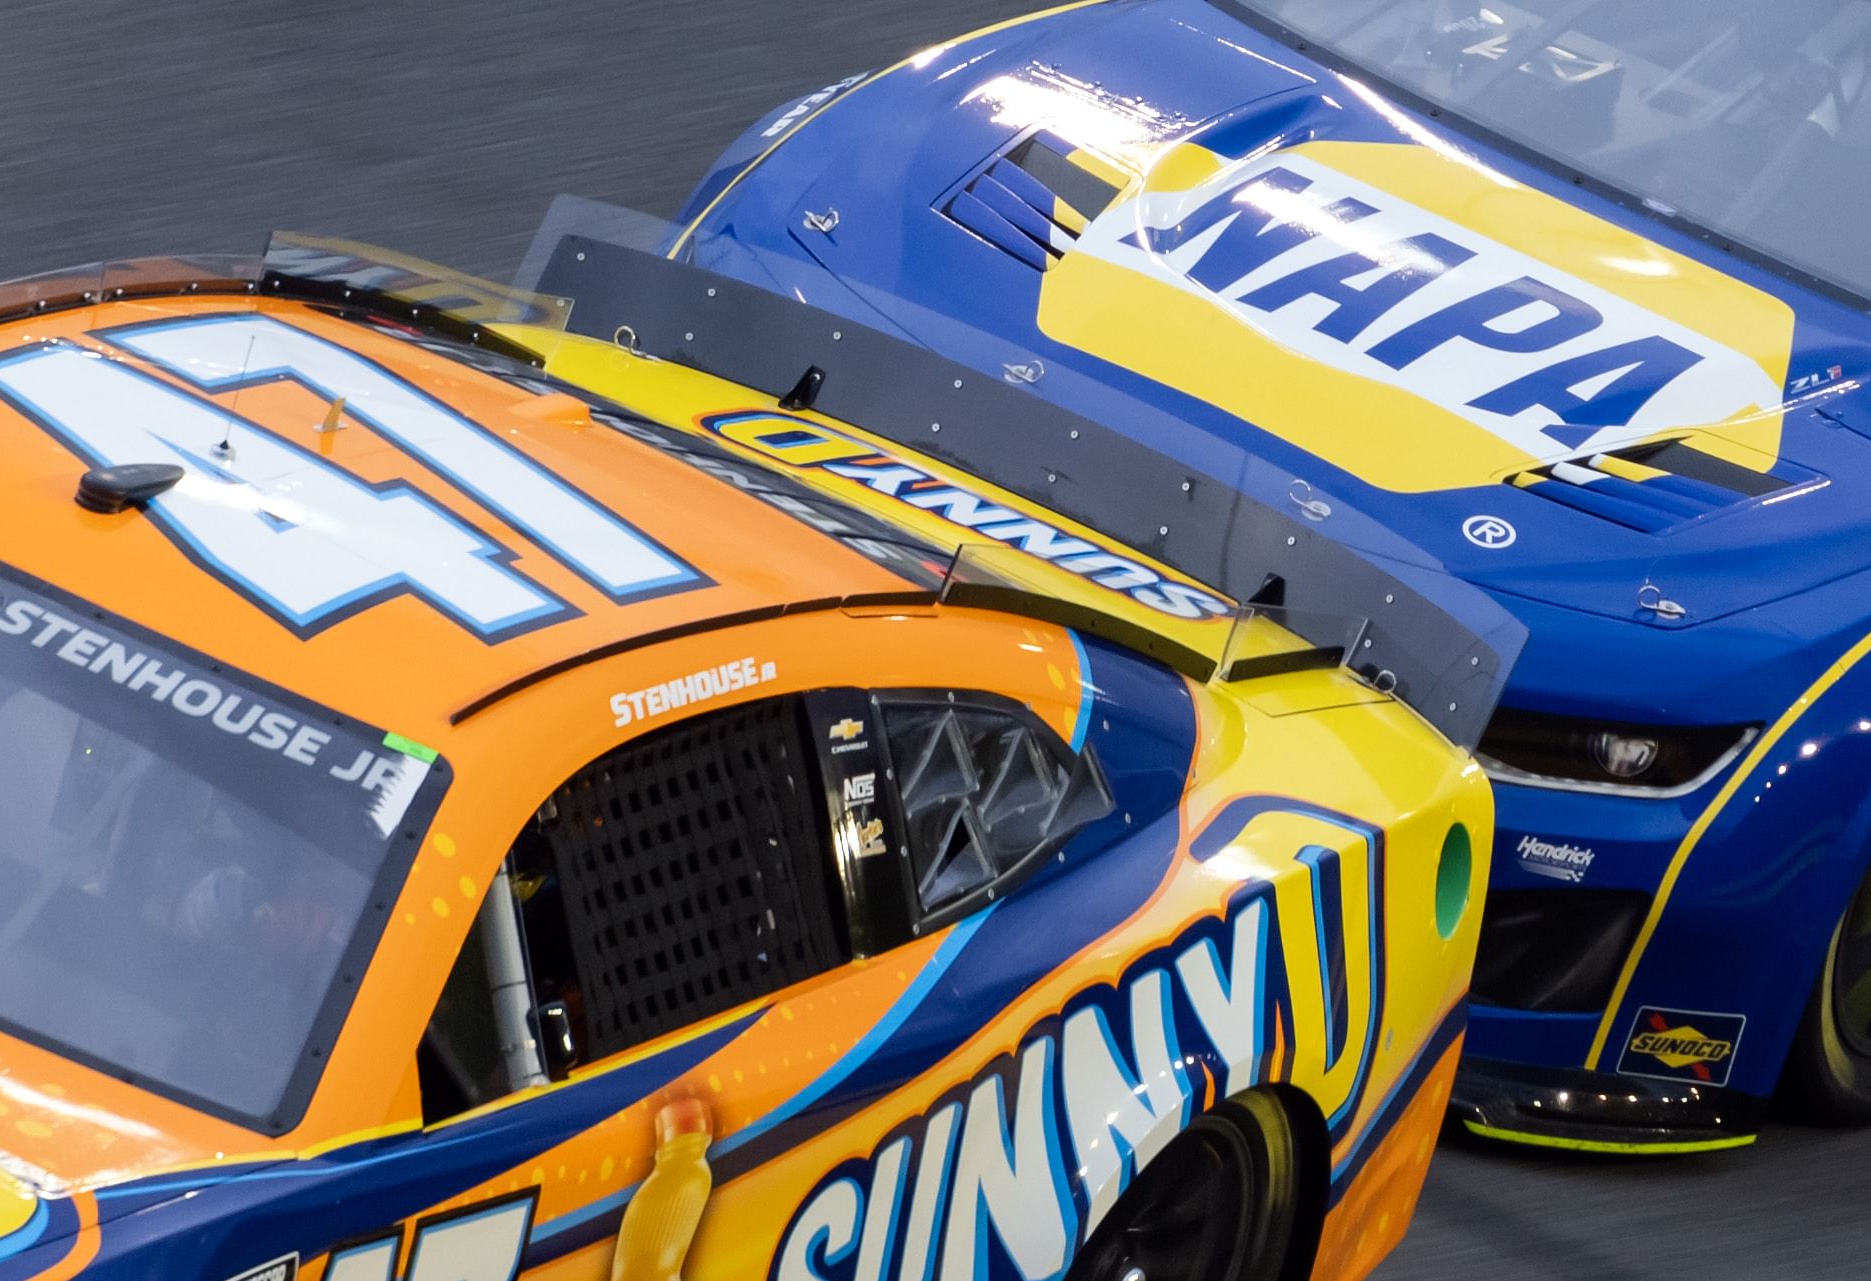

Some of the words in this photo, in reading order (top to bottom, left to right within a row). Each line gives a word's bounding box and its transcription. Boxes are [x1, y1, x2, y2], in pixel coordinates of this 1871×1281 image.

[1120, 166, 1706, 450] NAPA
[843, 772, 876, 801] NOS
[1517, 835, 1595, 869] Hendrick
[1632, 1031, 1732, 1062] SUNOCO
